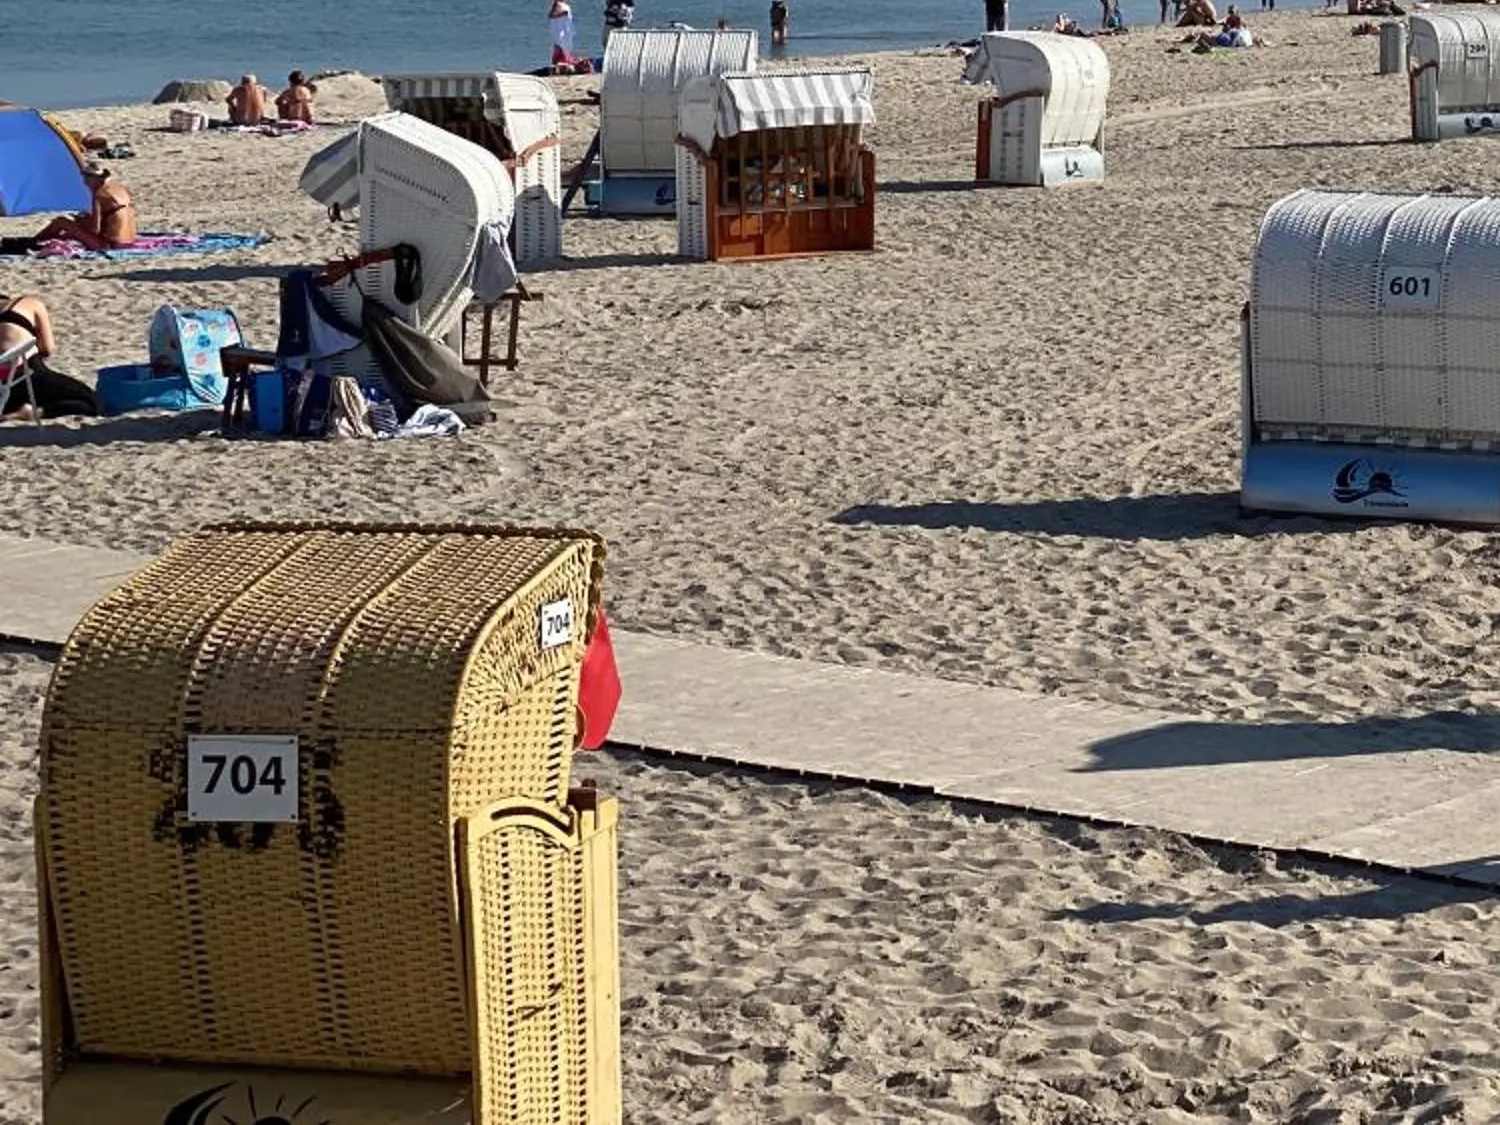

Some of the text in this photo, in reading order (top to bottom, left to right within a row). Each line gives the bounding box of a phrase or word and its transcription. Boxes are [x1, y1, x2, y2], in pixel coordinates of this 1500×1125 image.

[1388, 276, 1431, 297] 601
[546, 612, 570, 637] 704
[202, 754, 287, 796] 704
